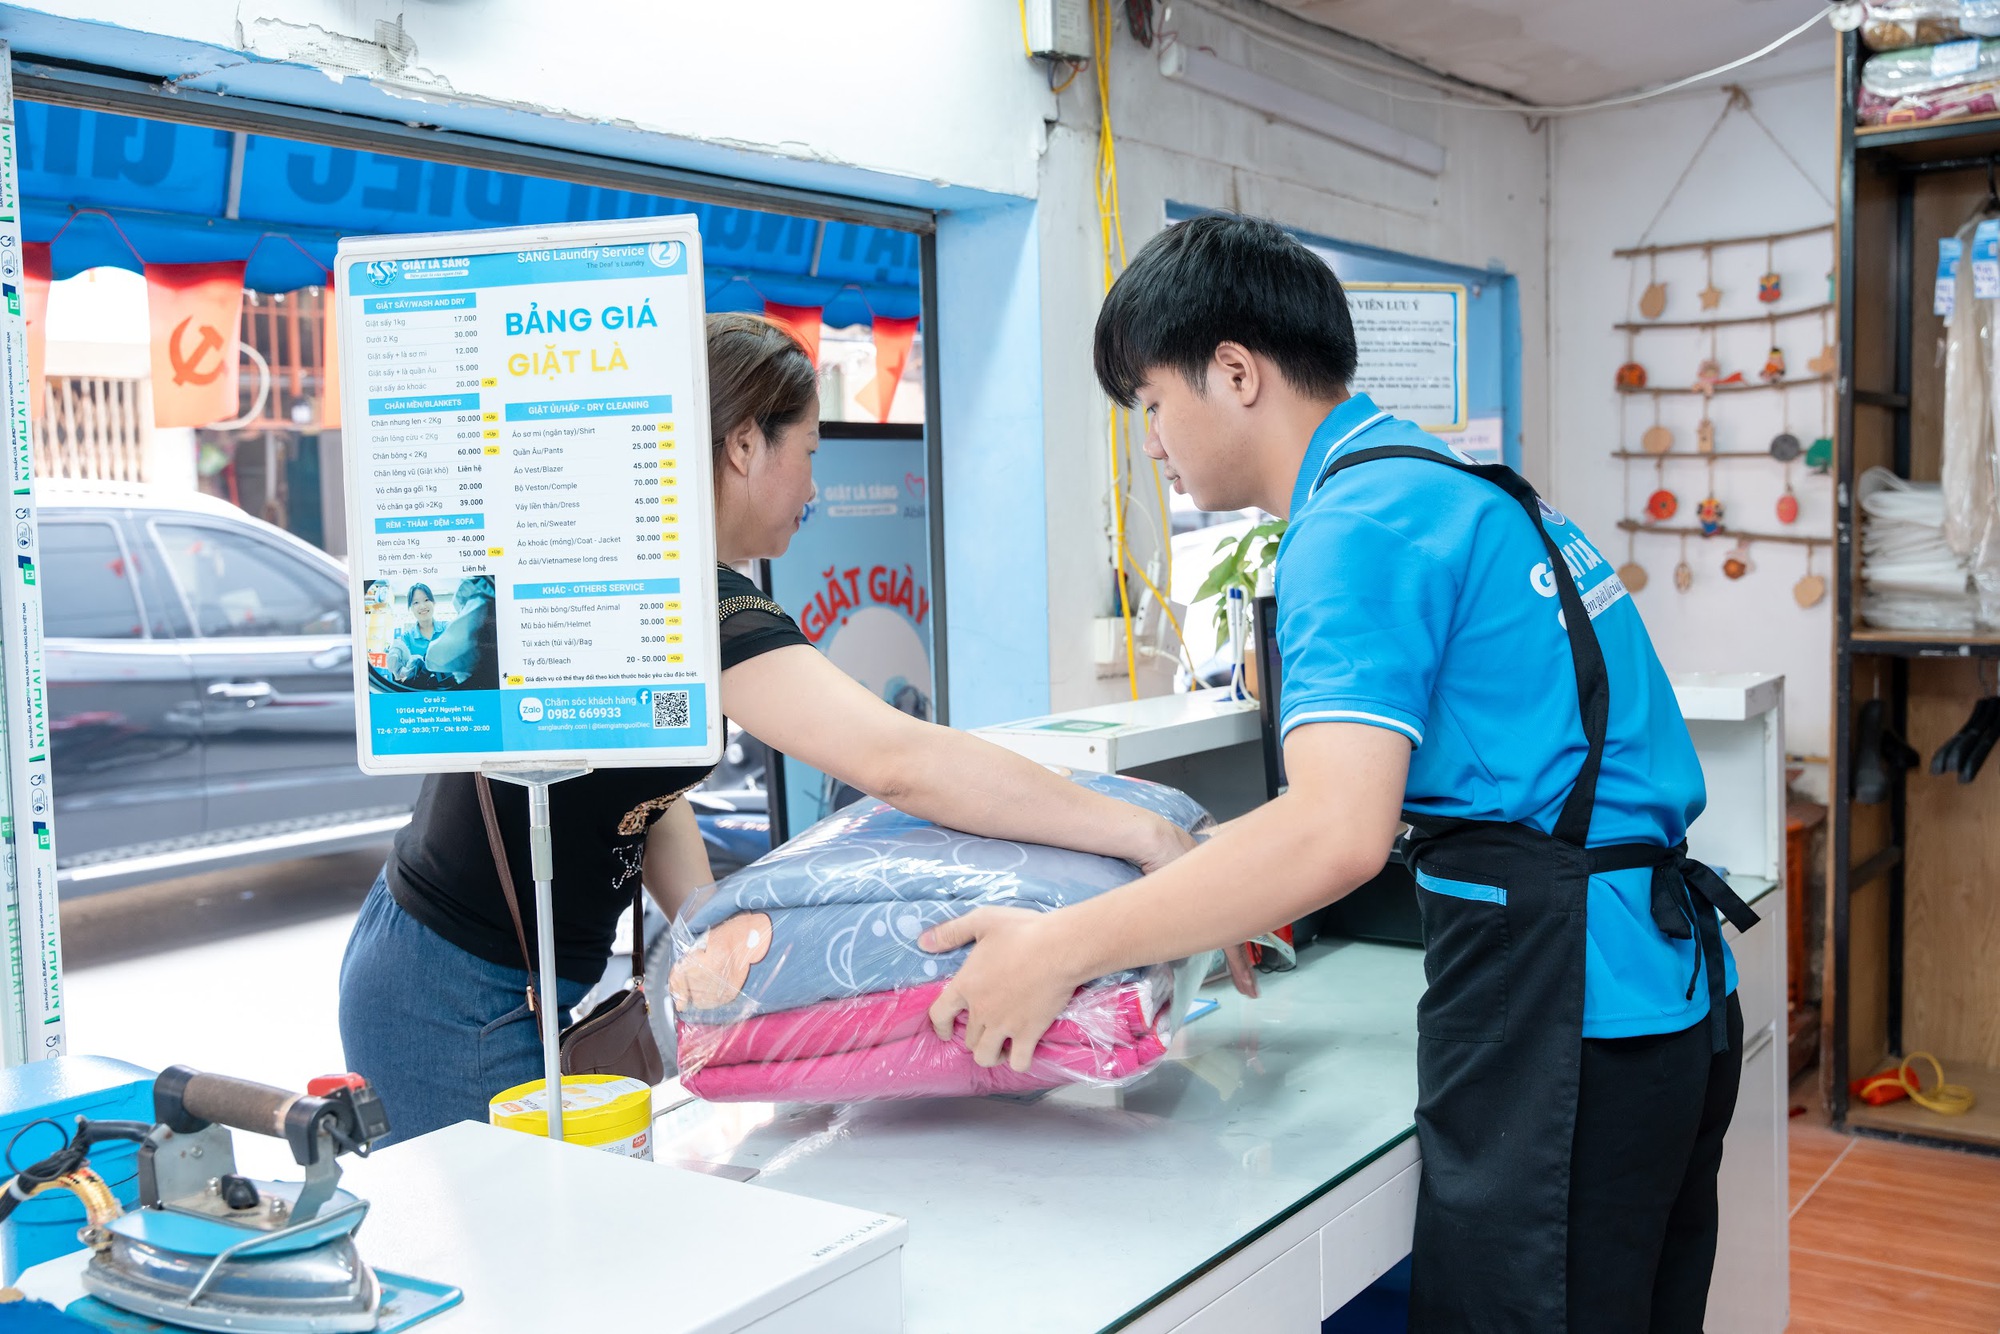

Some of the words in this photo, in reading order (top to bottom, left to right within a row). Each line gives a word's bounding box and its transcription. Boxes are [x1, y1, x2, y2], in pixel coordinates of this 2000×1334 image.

[505, 302, 592, 336] BẢNG
[601, 298, 658, 330] GIÁ
[455, 330, 477, 338] 30.000
[508, 343, 581, 381] GIẶT
[591, 341, 629, 372] LÀ
[456, 379, 480, 387] 20.000
[458, 414, 481, 422] 50.000
[459, 549, 487, 557] 150.000
[801, 565, 861, 643] GIẶT
[868, 564, 929, 625] GIÀY
[522, 706, 541, 714] Zalo
[548, 709, 576, 719] 0982
[579, 707, 621, 718] 669933
